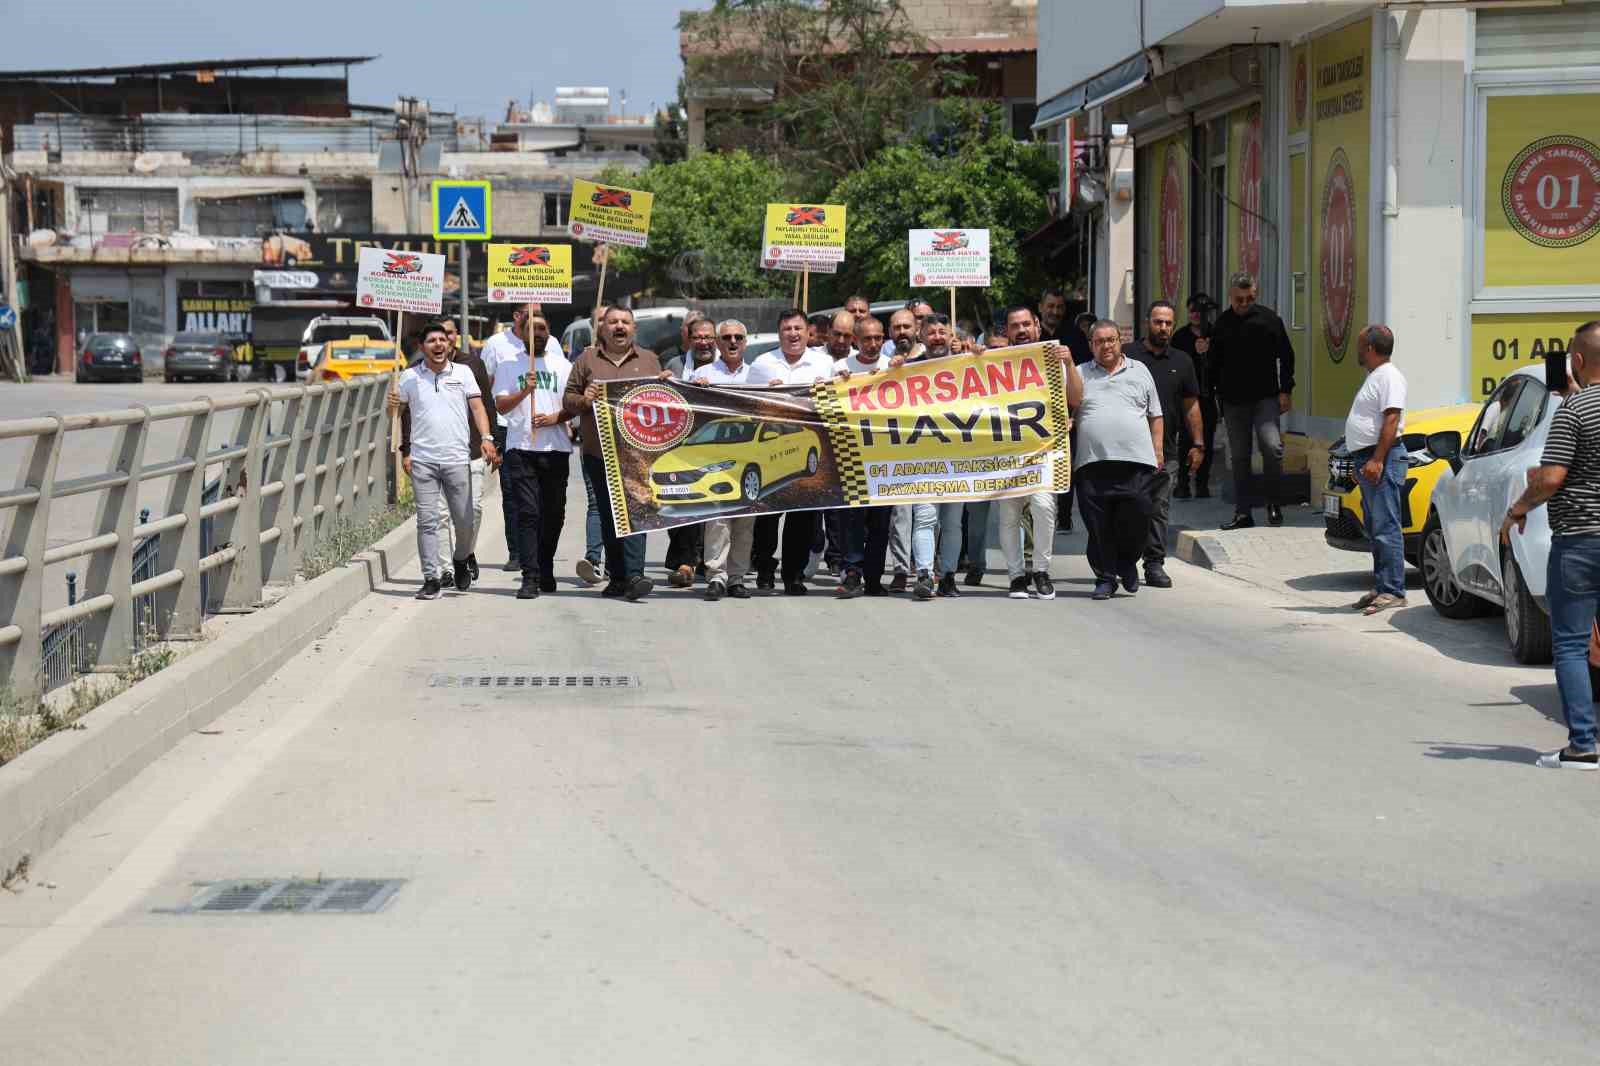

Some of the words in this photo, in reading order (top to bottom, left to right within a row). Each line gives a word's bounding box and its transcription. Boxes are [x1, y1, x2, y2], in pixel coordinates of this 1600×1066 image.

[1536, 174, 1583, 210] 01
[1492, 338, 1519, 360] 01
[1529, 338, 1574, 360] AD
[848, 357, 1045, 411] KORSANA
[636, 402, 676, 428] 01
[859, 400, 1051, 447] HAYIR
[869, 464, 888, 478] 01
[893, 461, 948, 477] ADANA
[878, 480, 970, 497] DAYANIŞMA
[973, 469, 1042, 489] DERNEĞİ
